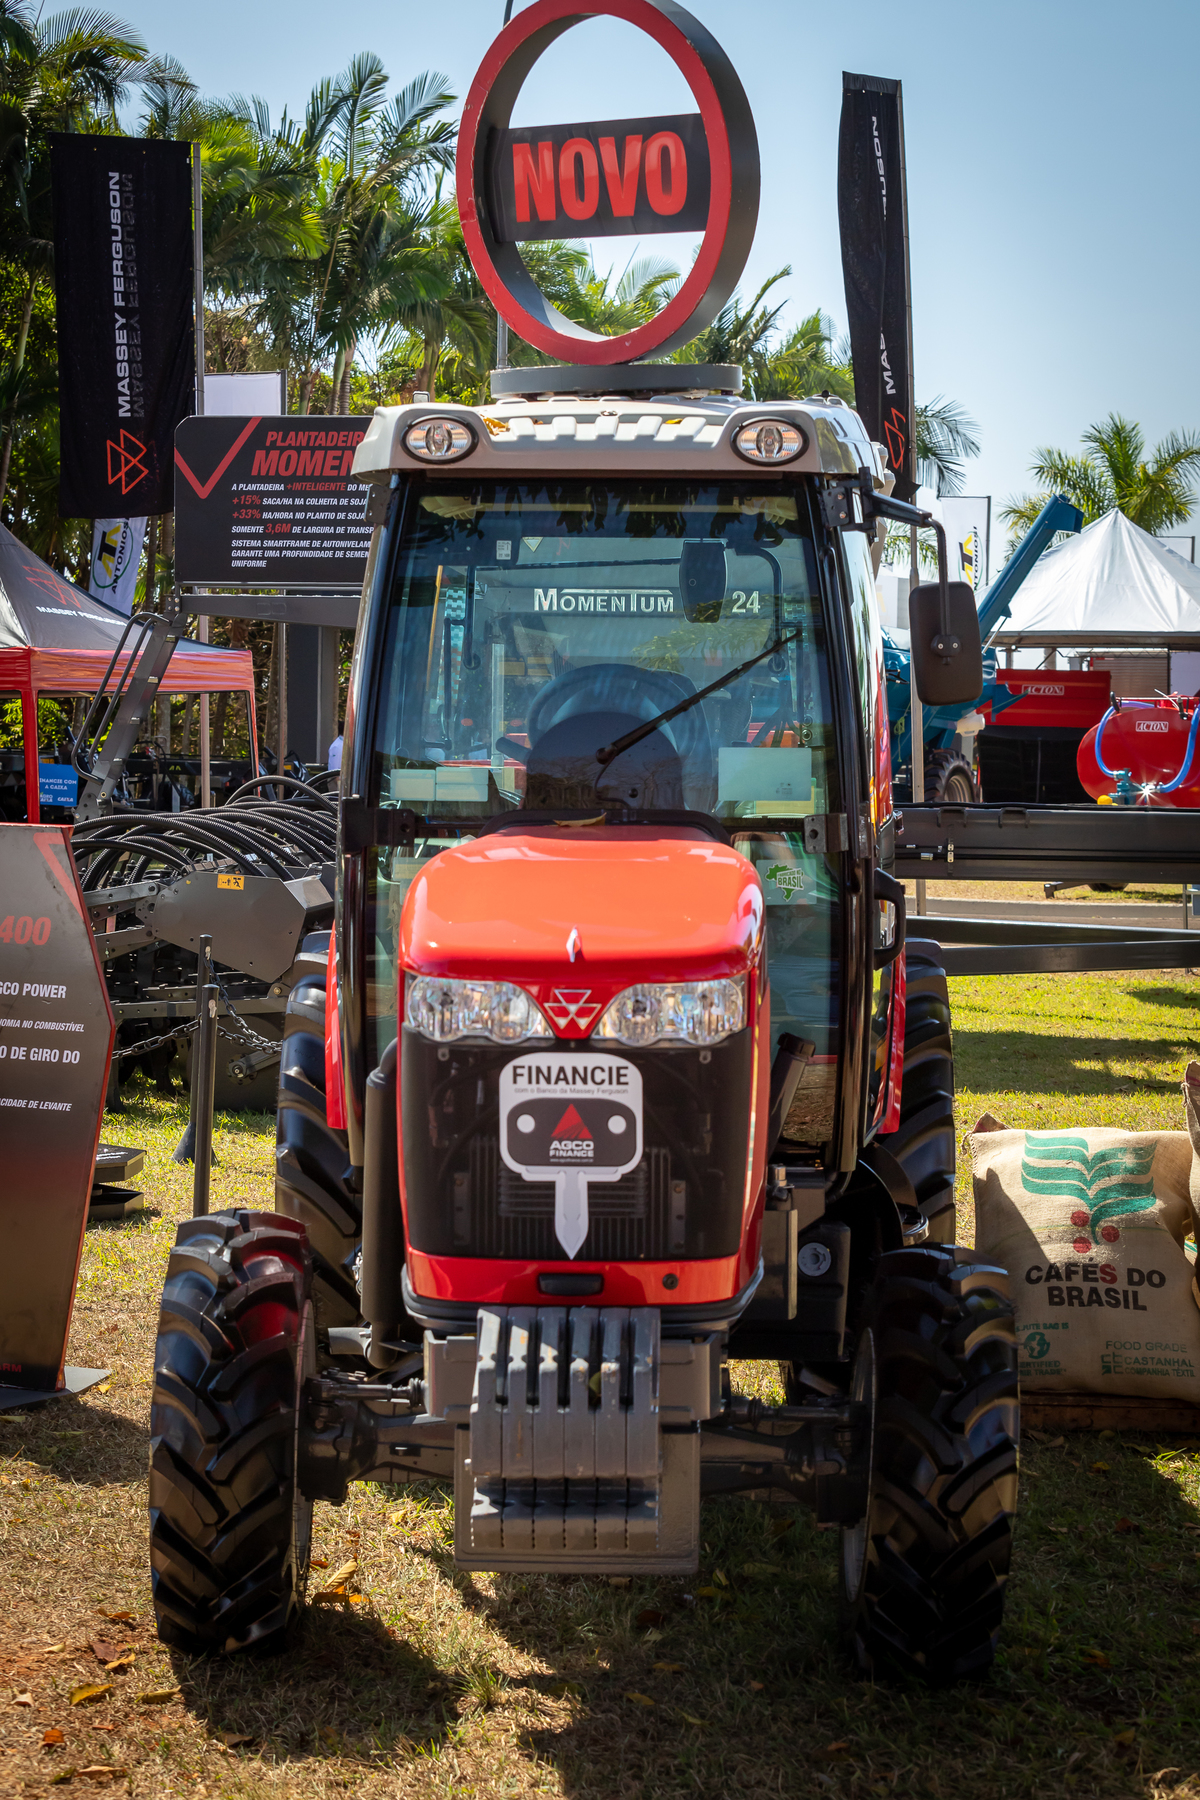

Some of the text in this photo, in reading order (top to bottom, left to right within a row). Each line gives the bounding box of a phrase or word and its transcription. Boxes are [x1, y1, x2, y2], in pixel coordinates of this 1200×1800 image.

[512, 131, 688, 223] NOVO
[108, 171, 132, 418] MASSEY FERGUSON
[231, 483, 238, 491] A
[238, 483, 285, 491] PLANTADEIRA
[286, 482, 347, 492] +INTELIGENTE
[232, 494, 261, 505] +15%
[262, 497, 293, 505] SACA/HA
[305, 498, 338, 506] COLHEITA
[339, 498, 350, 506] DE
[232, 509, 261, 519] +33%
[306, 512, 334, 520] PLANTIO
[336, 512, 347, 520] DE
[347, 512, 365, 520] SOJA
[231, 525, 264, 533] SOMENTE
[265, 523, 291, 534] 3,6M
[303, 526, 335, 534] LARGURA
[335, 526, 346, 534] DE
[262, 540, 310, 548] SMARTFRAME
[311, 540, 321, 548] DE
[231, 549, 263, 557] GARANTE
[281, 550, 334, 558] PROFUNDIDADE
[334, 550, 344, 558] DE
[231, 560, 267, 568] UNIFORME
[731, 590, 761, 614] 24
[1027, 684, 1064, 695] ACTON
[1137, 721, 1168, 732] ACTON
[777, 875, 804, 889] BRASIL
[22, 982, 67, 999] POWER
[22, 1019, 34, 1029] NO
[34, 1020, 85, 1033] COMBUSTÍVEL
[10, 1046, 27, 1060] DE
[30, 1047, 60, 1063] GIRO
[62, 1050, 81, 1064] DO
[512, 1065, 630, 1086] FINANCIE
[28, 1099, 40, 1109] DE
[39, 1101, 73, 1112] LEVANTE
[549, 1140, 594, 1150] AGCO
[1025, 1257, 1167, 1289] CAFÉS DO
[1047, 1285, 1148, 1312] BRASIL
[1105, 1340, 1188, 1354] FOOD GRADE
[1124, 1355, 1196, 1368] CASTANHAL
[1124, 1366, 1171, 1377] COMPANHIA
